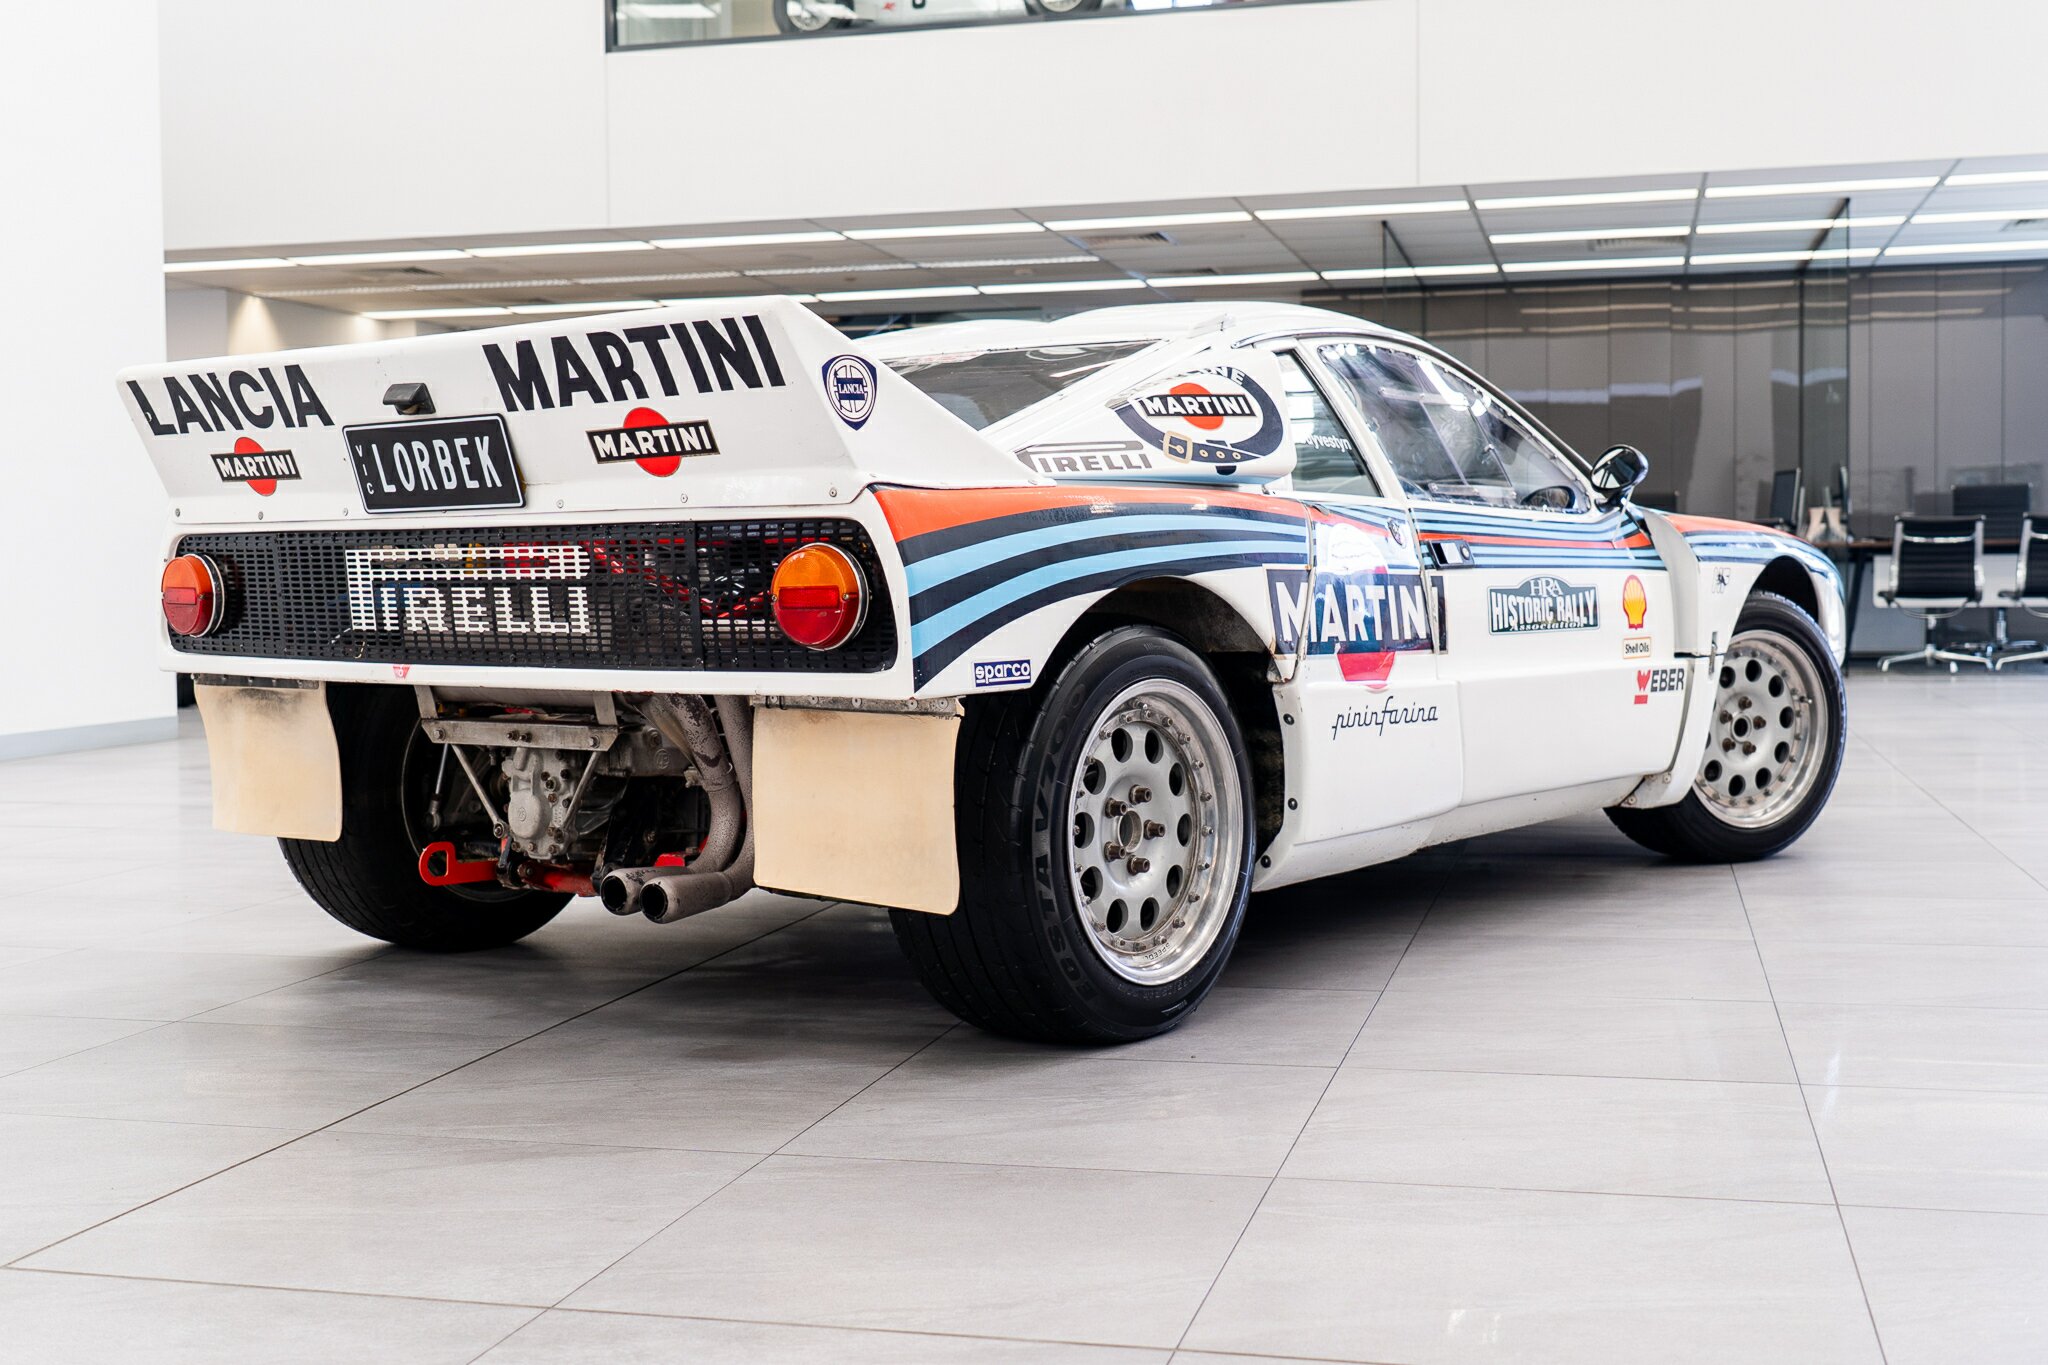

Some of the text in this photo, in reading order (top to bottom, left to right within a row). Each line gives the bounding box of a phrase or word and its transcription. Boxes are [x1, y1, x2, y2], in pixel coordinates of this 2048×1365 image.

[482, 314, 786, 412] MARTINI
[126, 364, 335, 436] LANCIA
[838, 383, 865, 395] LANCIA
[1147, 395, 1251, 417] MARTINI
[593, 426, 713, 459] MARTINI
[216, 453, 297, 478] MARTINI
[355, 444, 376, 495] VIC
[372, 435, 502, 493] LORBEK
[345, 546, 591, 633] PIRELLI
[1530, 577, 1563, 598] HRA
[1276, 581, 1439, 643] MARTINI
[1491, 589, 1595, 632] HISTORIC RALLY
[1509, 620, 1585, 632] Association
[1625, 642, 1650, 655] Shell Oils
[975, 662, 1031, 684] sparco
[1637, 668, 1685, 693] WEBER
[1332, 696, 1439, 741] pininfarina
